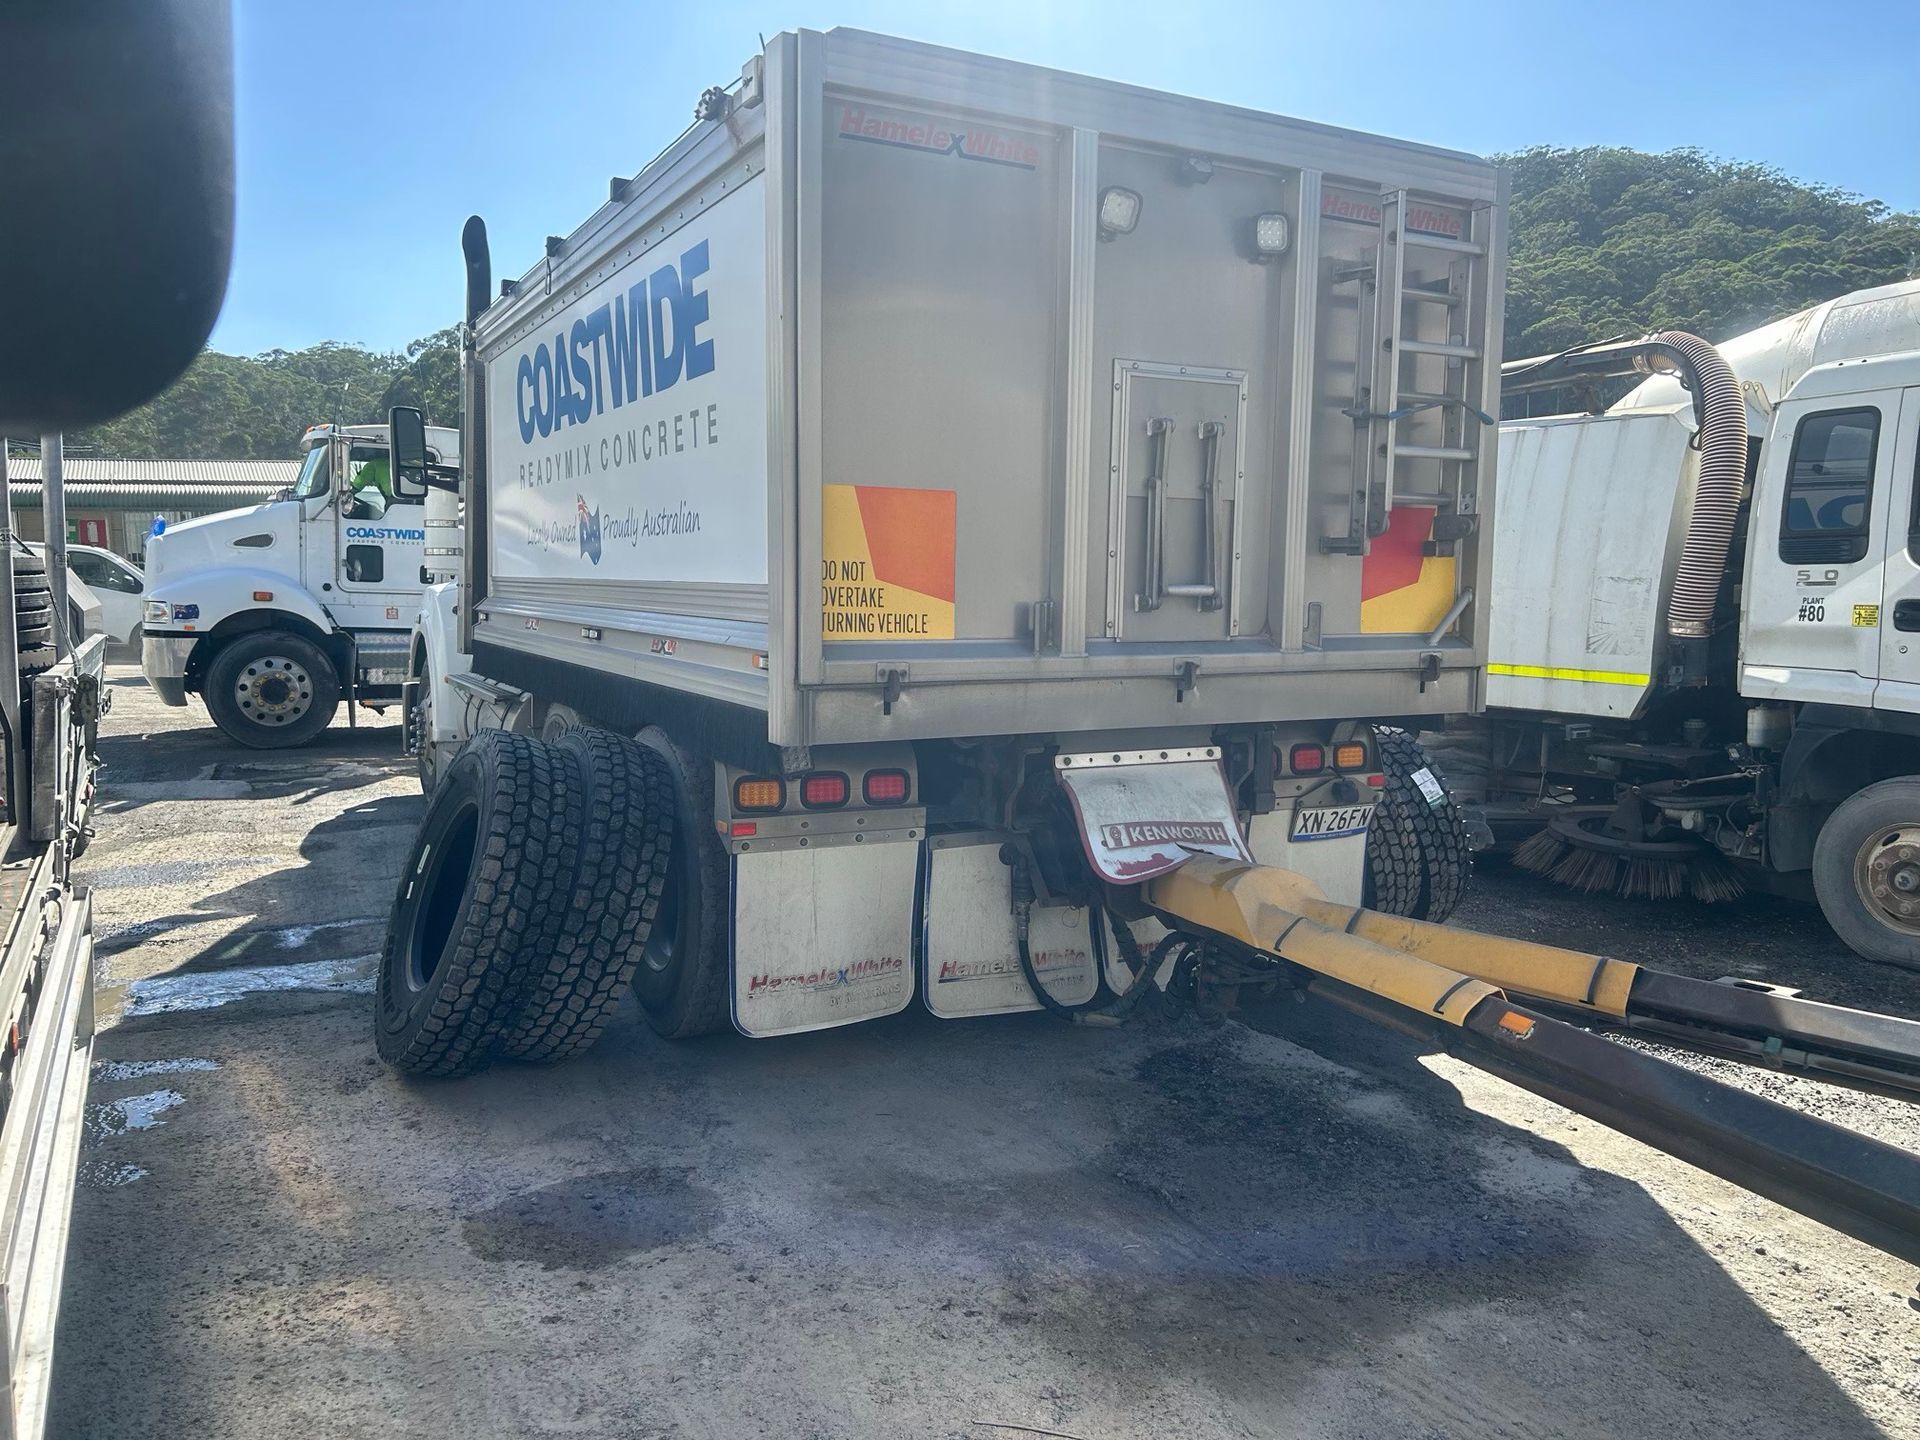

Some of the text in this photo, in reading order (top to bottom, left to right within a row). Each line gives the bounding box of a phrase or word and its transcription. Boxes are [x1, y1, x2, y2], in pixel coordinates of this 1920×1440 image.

[517, 238, 715, 445] COASTWIDE
[519, 403, 718, 490] READYMIX CONCRETE
[550, 514, 577, 544] Owned
[603, 507, 638, 547] Proudly
[641, 500, 701, 538] Australian
[822, 560, 866, 581] DO NOT
[822, 587, 885, 607] OVERTAKE
[1802, 597, 1825, 605] PLANT
[822, 612, 928, 633] TURNING VEHICLE
[1798, 605, 1825, 622] #80
[1129, 825, 1228, 842] KENWORTH
